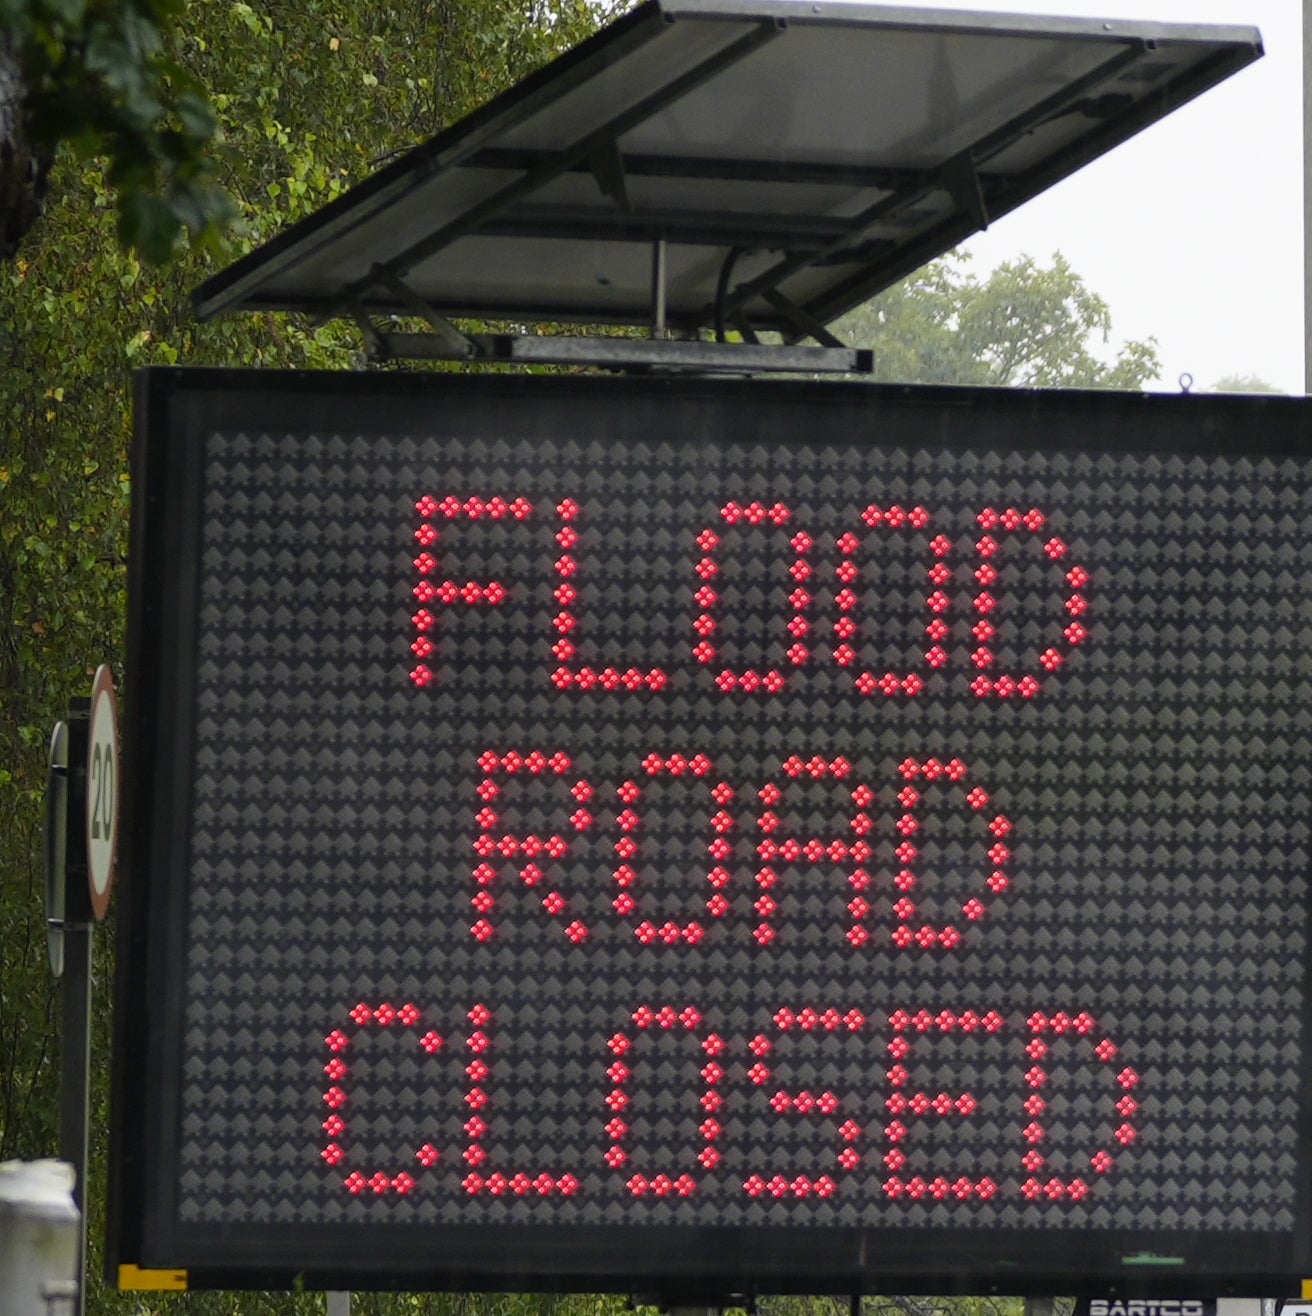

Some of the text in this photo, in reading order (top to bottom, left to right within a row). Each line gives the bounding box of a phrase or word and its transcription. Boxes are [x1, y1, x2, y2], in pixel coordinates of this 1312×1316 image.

[408, 495, 1089, 699] FLOOD
[91, 742, 113, 842] 20
[470, 749, 1012, 948] ROAD
[321, 1001, 1139, 1201] CLOSED
[1089, 1299, 1203, 1316] BARTCO
